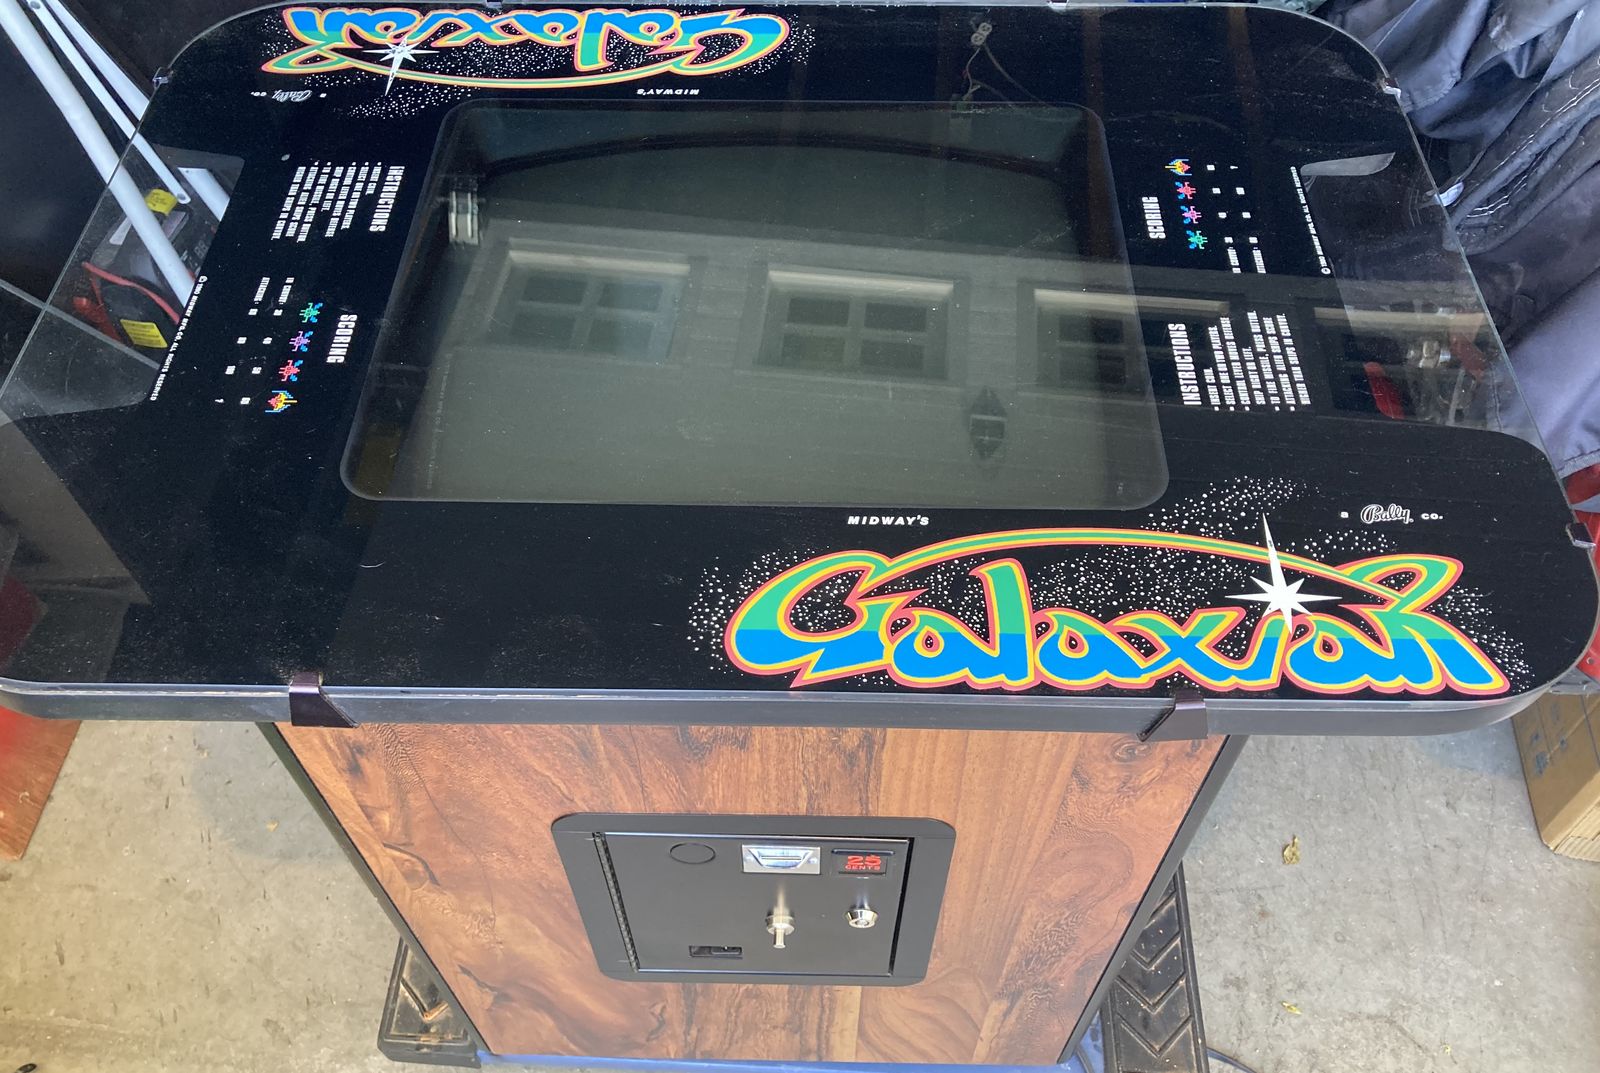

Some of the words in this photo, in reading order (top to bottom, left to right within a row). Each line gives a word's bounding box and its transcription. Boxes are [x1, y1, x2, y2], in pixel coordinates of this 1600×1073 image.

[272, 90, 312, 102] Bally
[369, 166, 404, 231] INSTRUCTIONS
[1142, 196, 1165, 238] SCORING
[326, 314, 357, 362] SCORING
[1168, 323, 1201, 404] INSTRUCTIONS
[1231, 362, 1244, 378] LEVER
[1222, 385, 1236, 404] SELECT
[848, 515, 929, 525] MIDWAY'S
[1360, 503, 1414, 524] Bally
[723, 530, 1511, 694] Galaxian
[847, 855, 881, 865] 25
